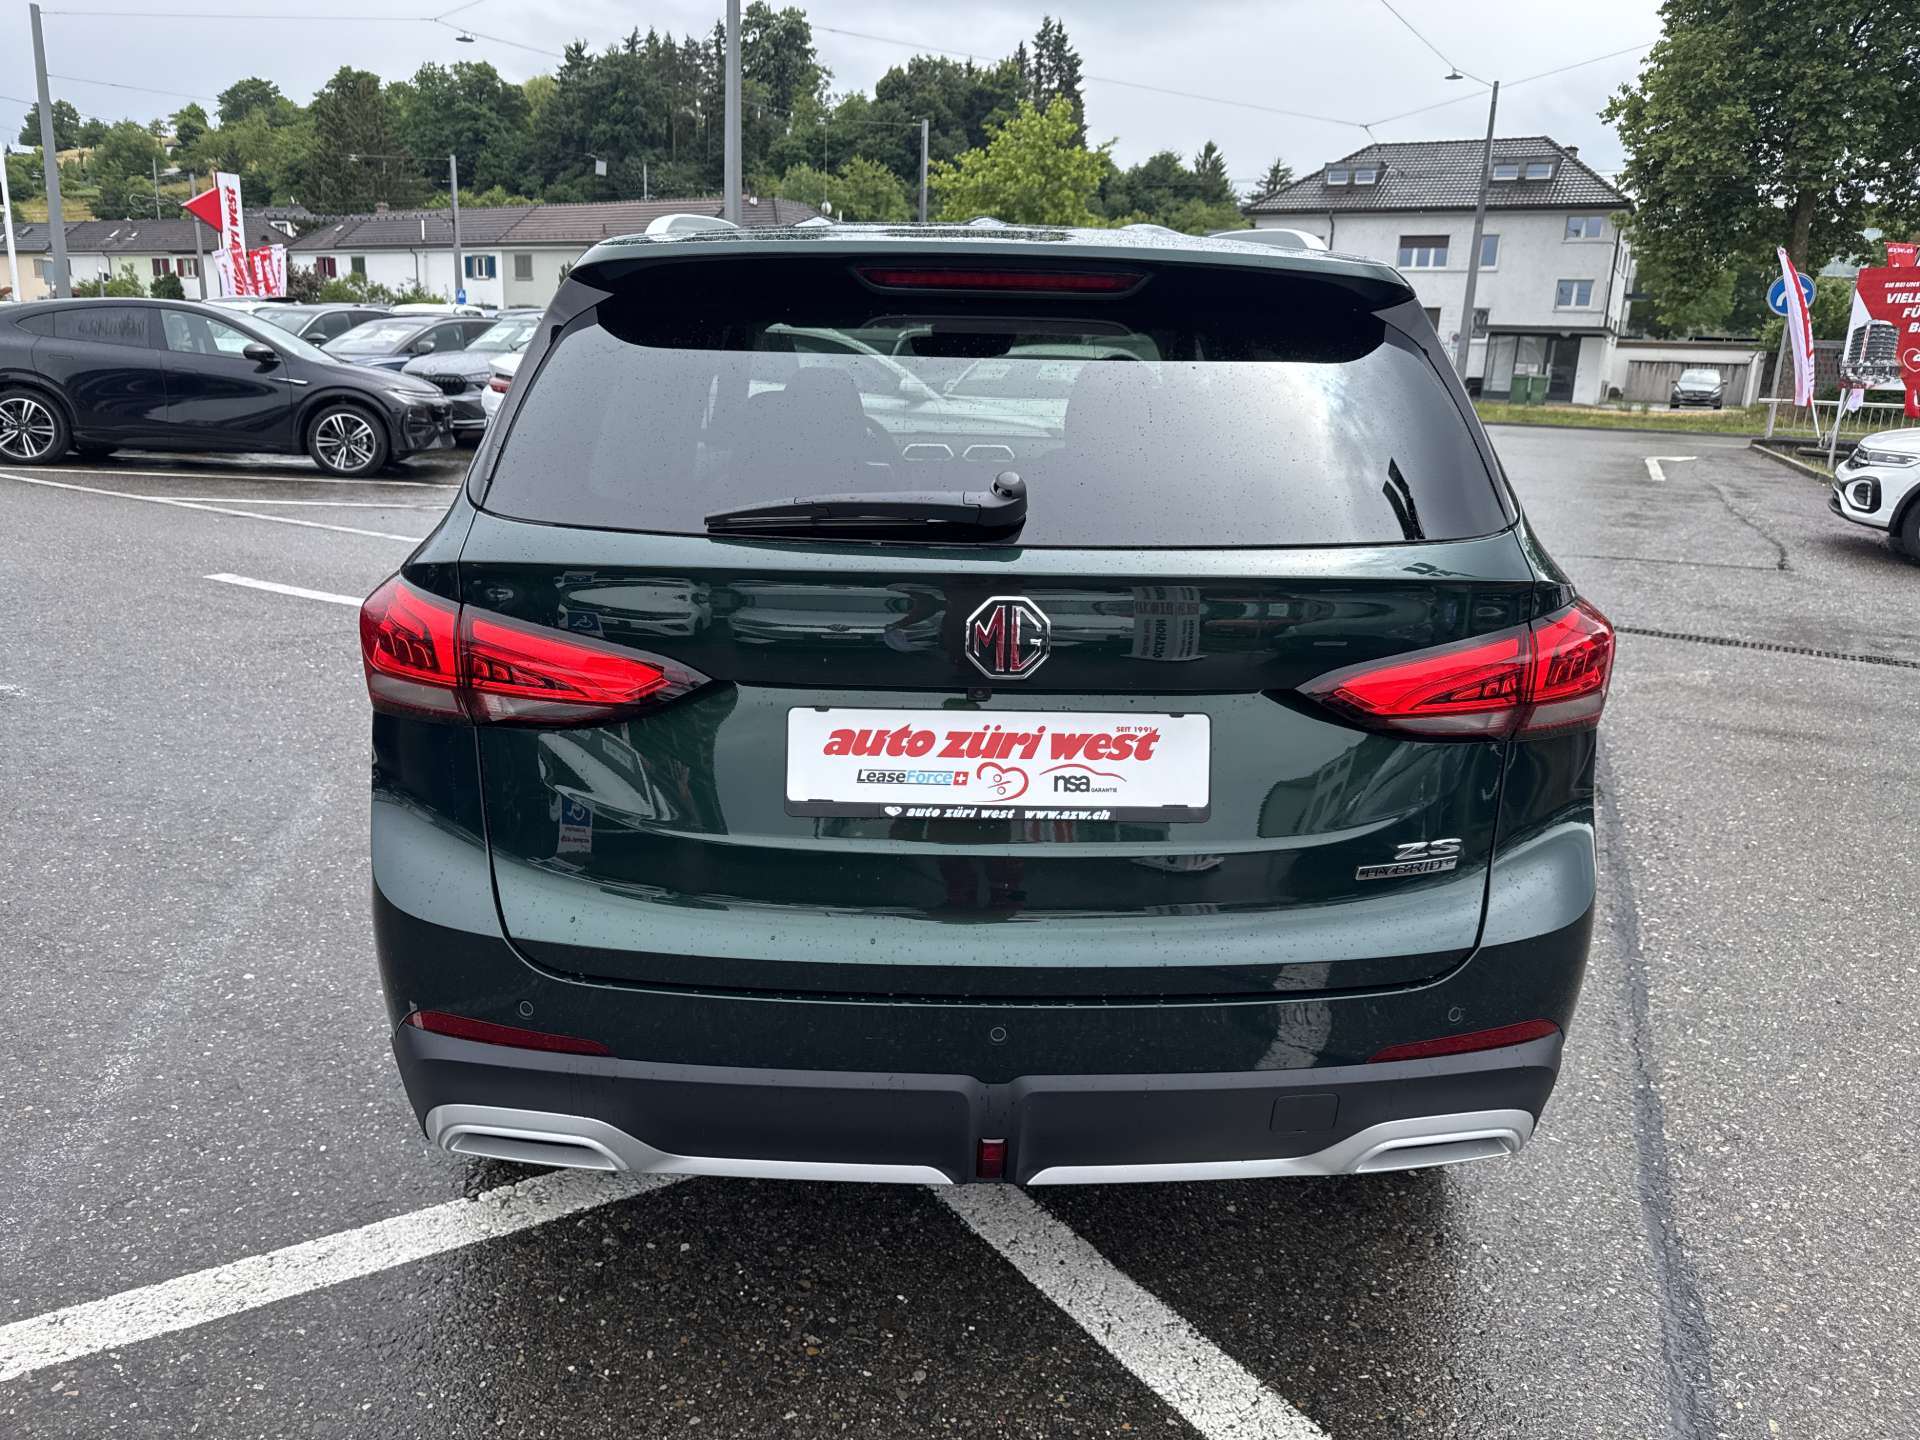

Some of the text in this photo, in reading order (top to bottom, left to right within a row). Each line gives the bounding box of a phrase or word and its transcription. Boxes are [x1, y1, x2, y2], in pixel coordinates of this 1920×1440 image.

[974, 605, 1042, 672] MG
[823, 723, 1161, 761] auto züri west
[857, 769, 953, 784] LeaseForce
[1054, 775, 1090, 792] nsa
[906, 806, 1111, 820] auto züri west www.azw.ch
[1394, 837, 1462, 860] ZS
